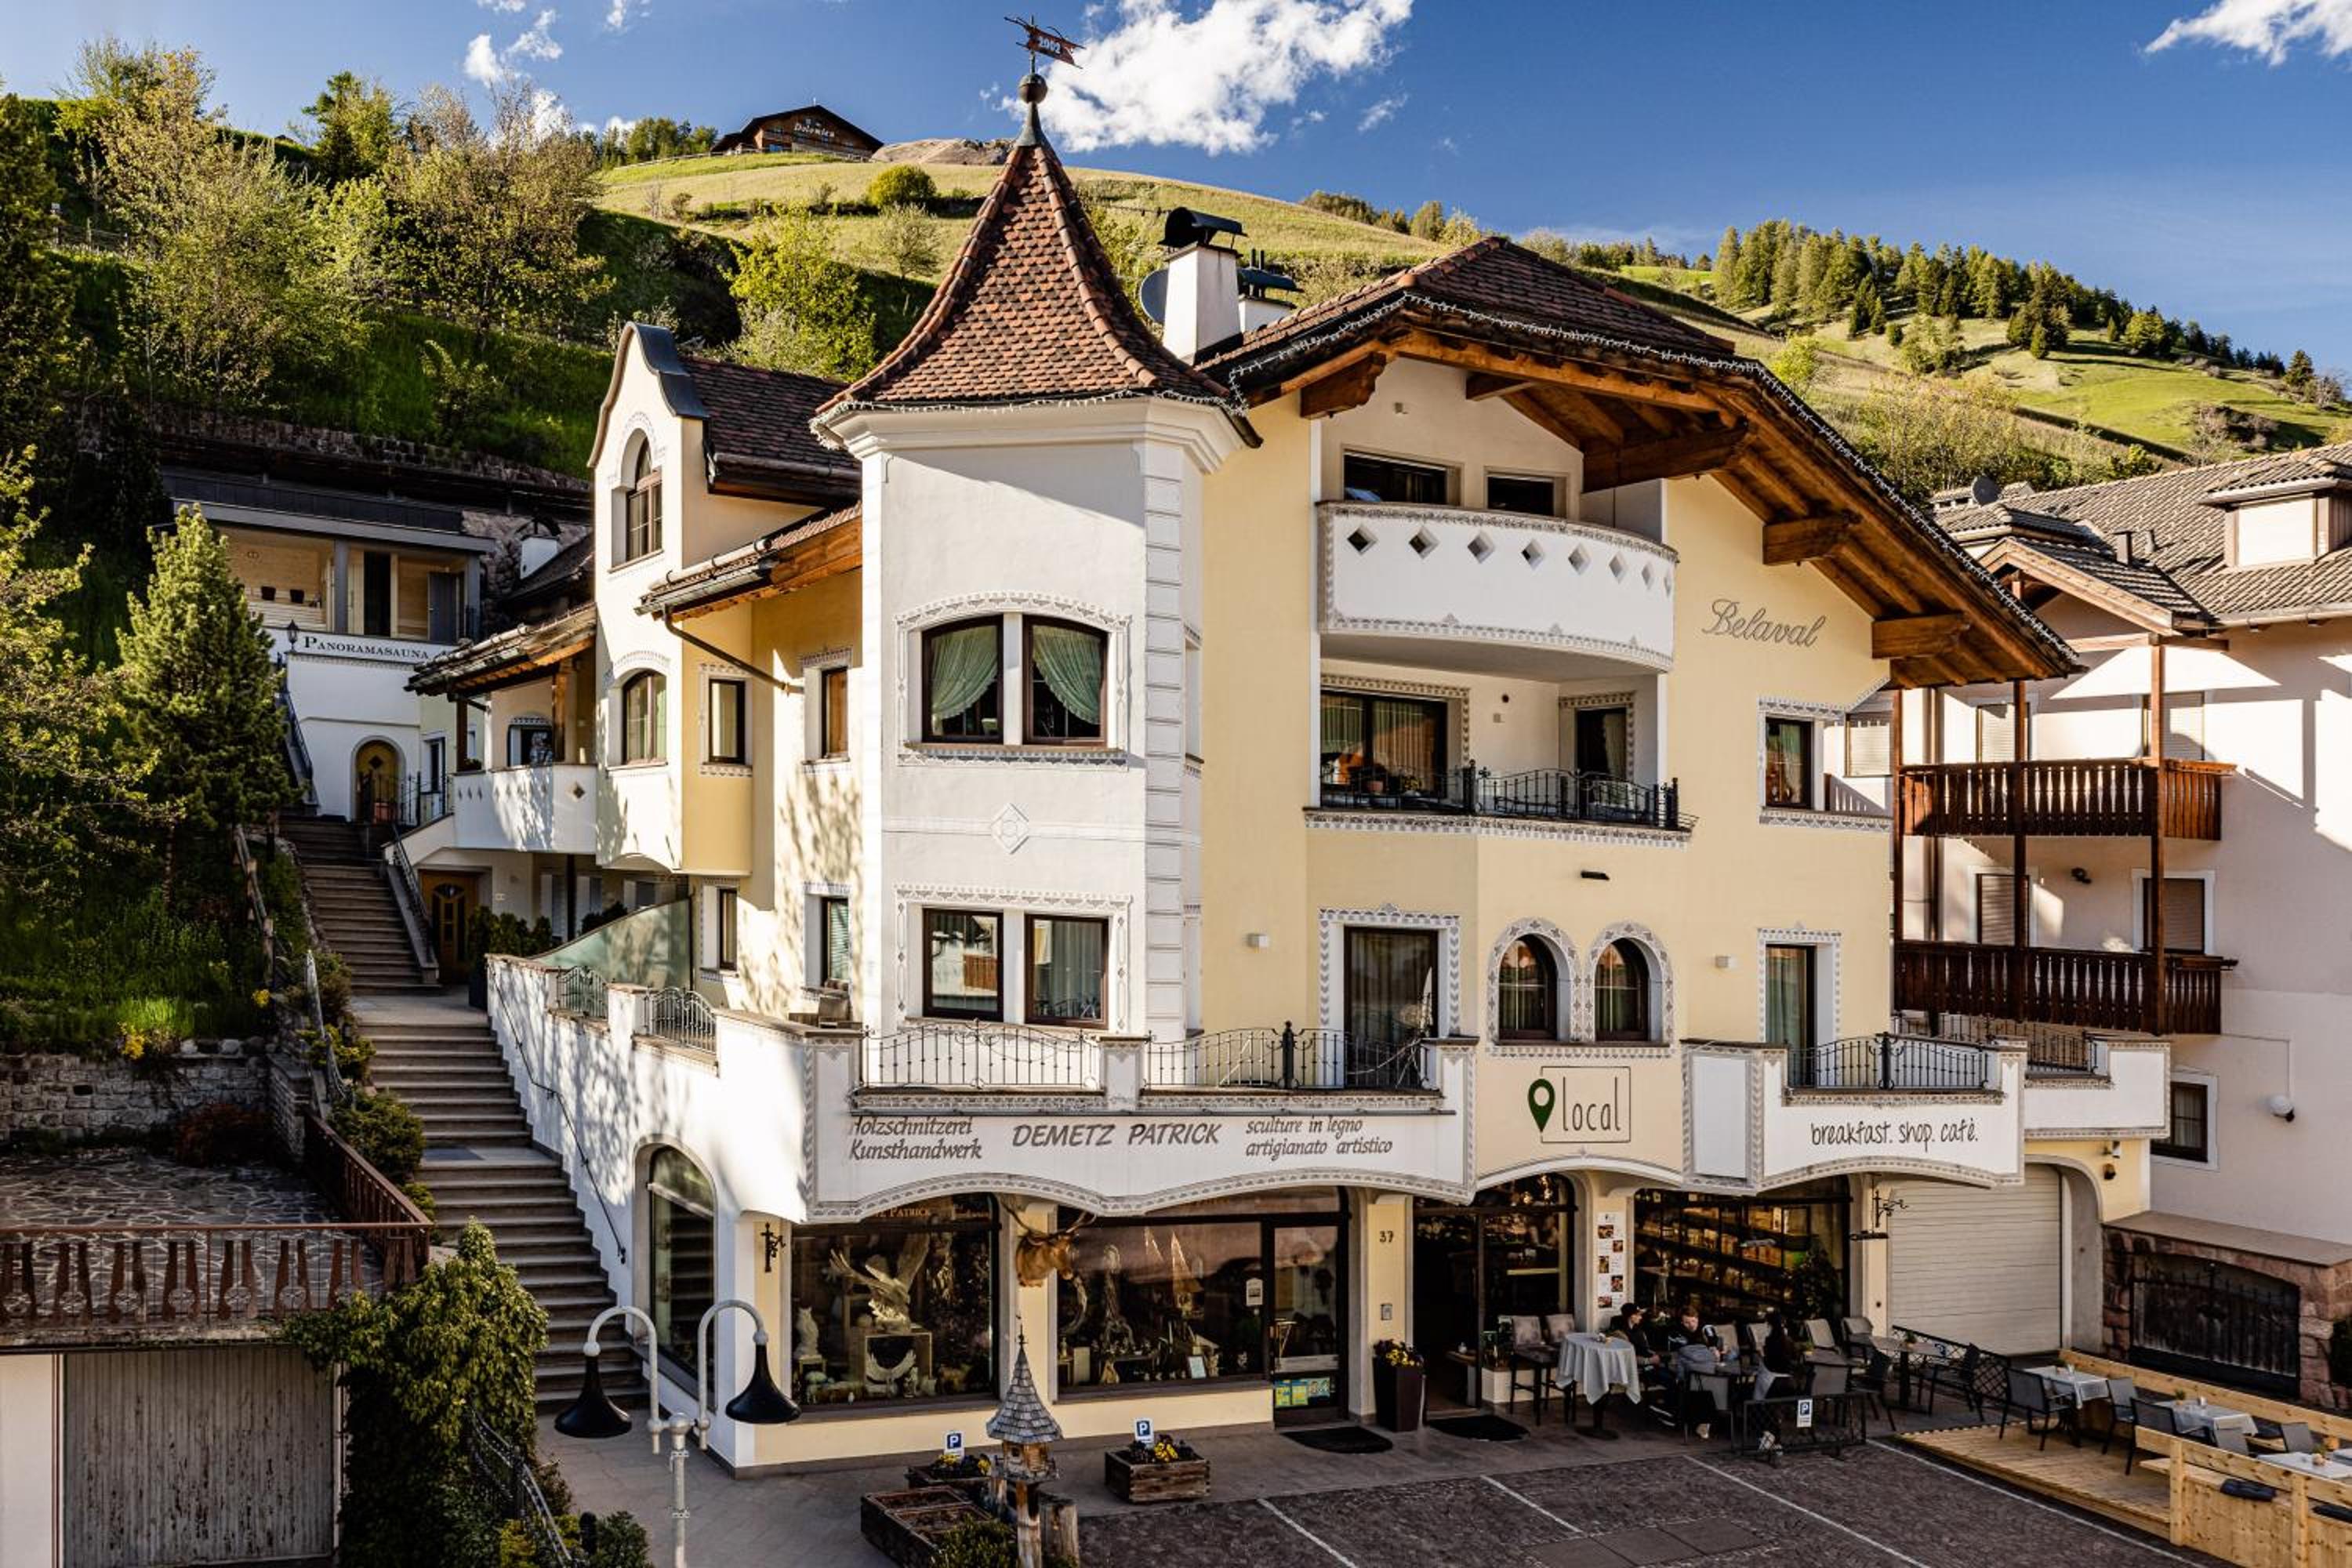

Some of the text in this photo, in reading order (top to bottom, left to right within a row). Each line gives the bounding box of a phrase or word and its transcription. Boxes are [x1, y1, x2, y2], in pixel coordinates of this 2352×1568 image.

[1701, 598, 1826, 648] Belaval
[1563, 1076, 1621, 1131] local
[1012, 1123, 1222, 1147] DEMETZ PATRICK
[1246, 1115, 1363, 1139] sculture in legno
[1811, 1120, 1893, 1145] breakfast.
[1898, 1121, 1935, 1152] shop.
[850, 1138, 982, 1160] Kunsthandwerk
[1246, 1137, 1393, 1161] artigianato artistico
[1379, 1230, 1394, 1243] 37
[1138, 1422, 1149, 1436] P
[949, 1436, 959, 1448] P
